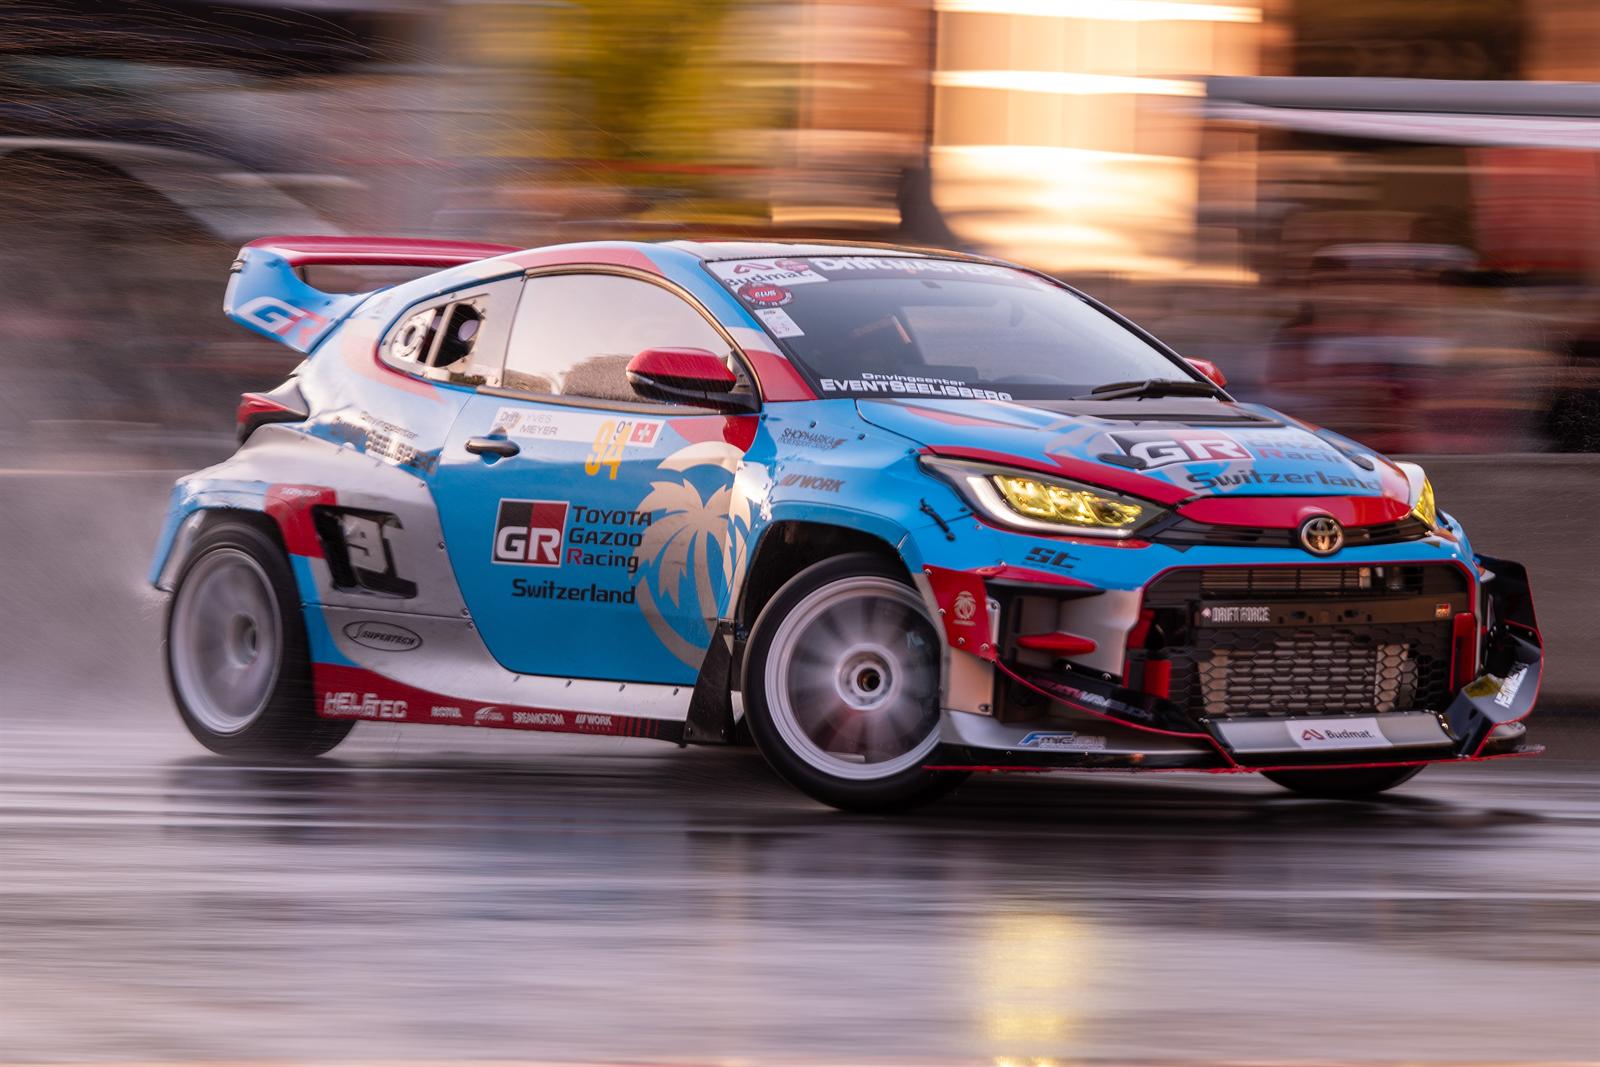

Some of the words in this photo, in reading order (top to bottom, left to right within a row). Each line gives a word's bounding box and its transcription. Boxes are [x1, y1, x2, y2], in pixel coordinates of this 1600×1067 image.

[235, 296, 328, 346] GR
[861, 372, 967, 387] Drivingcenter
[519, 424, 558, 436] MEYER
[1130, 438, 1246, 471] GR
[799, 475, 846, 493] WORK
[573, 506, 652, 527] TOYOTA
[496, 526, 561, 563] GR
[568, 527, 643, 547] GAZOO
[566, 548, 639, 574] Racing
[511, 578, 636, 605] Switzerland
[587, 714, 613, 726] WORK
